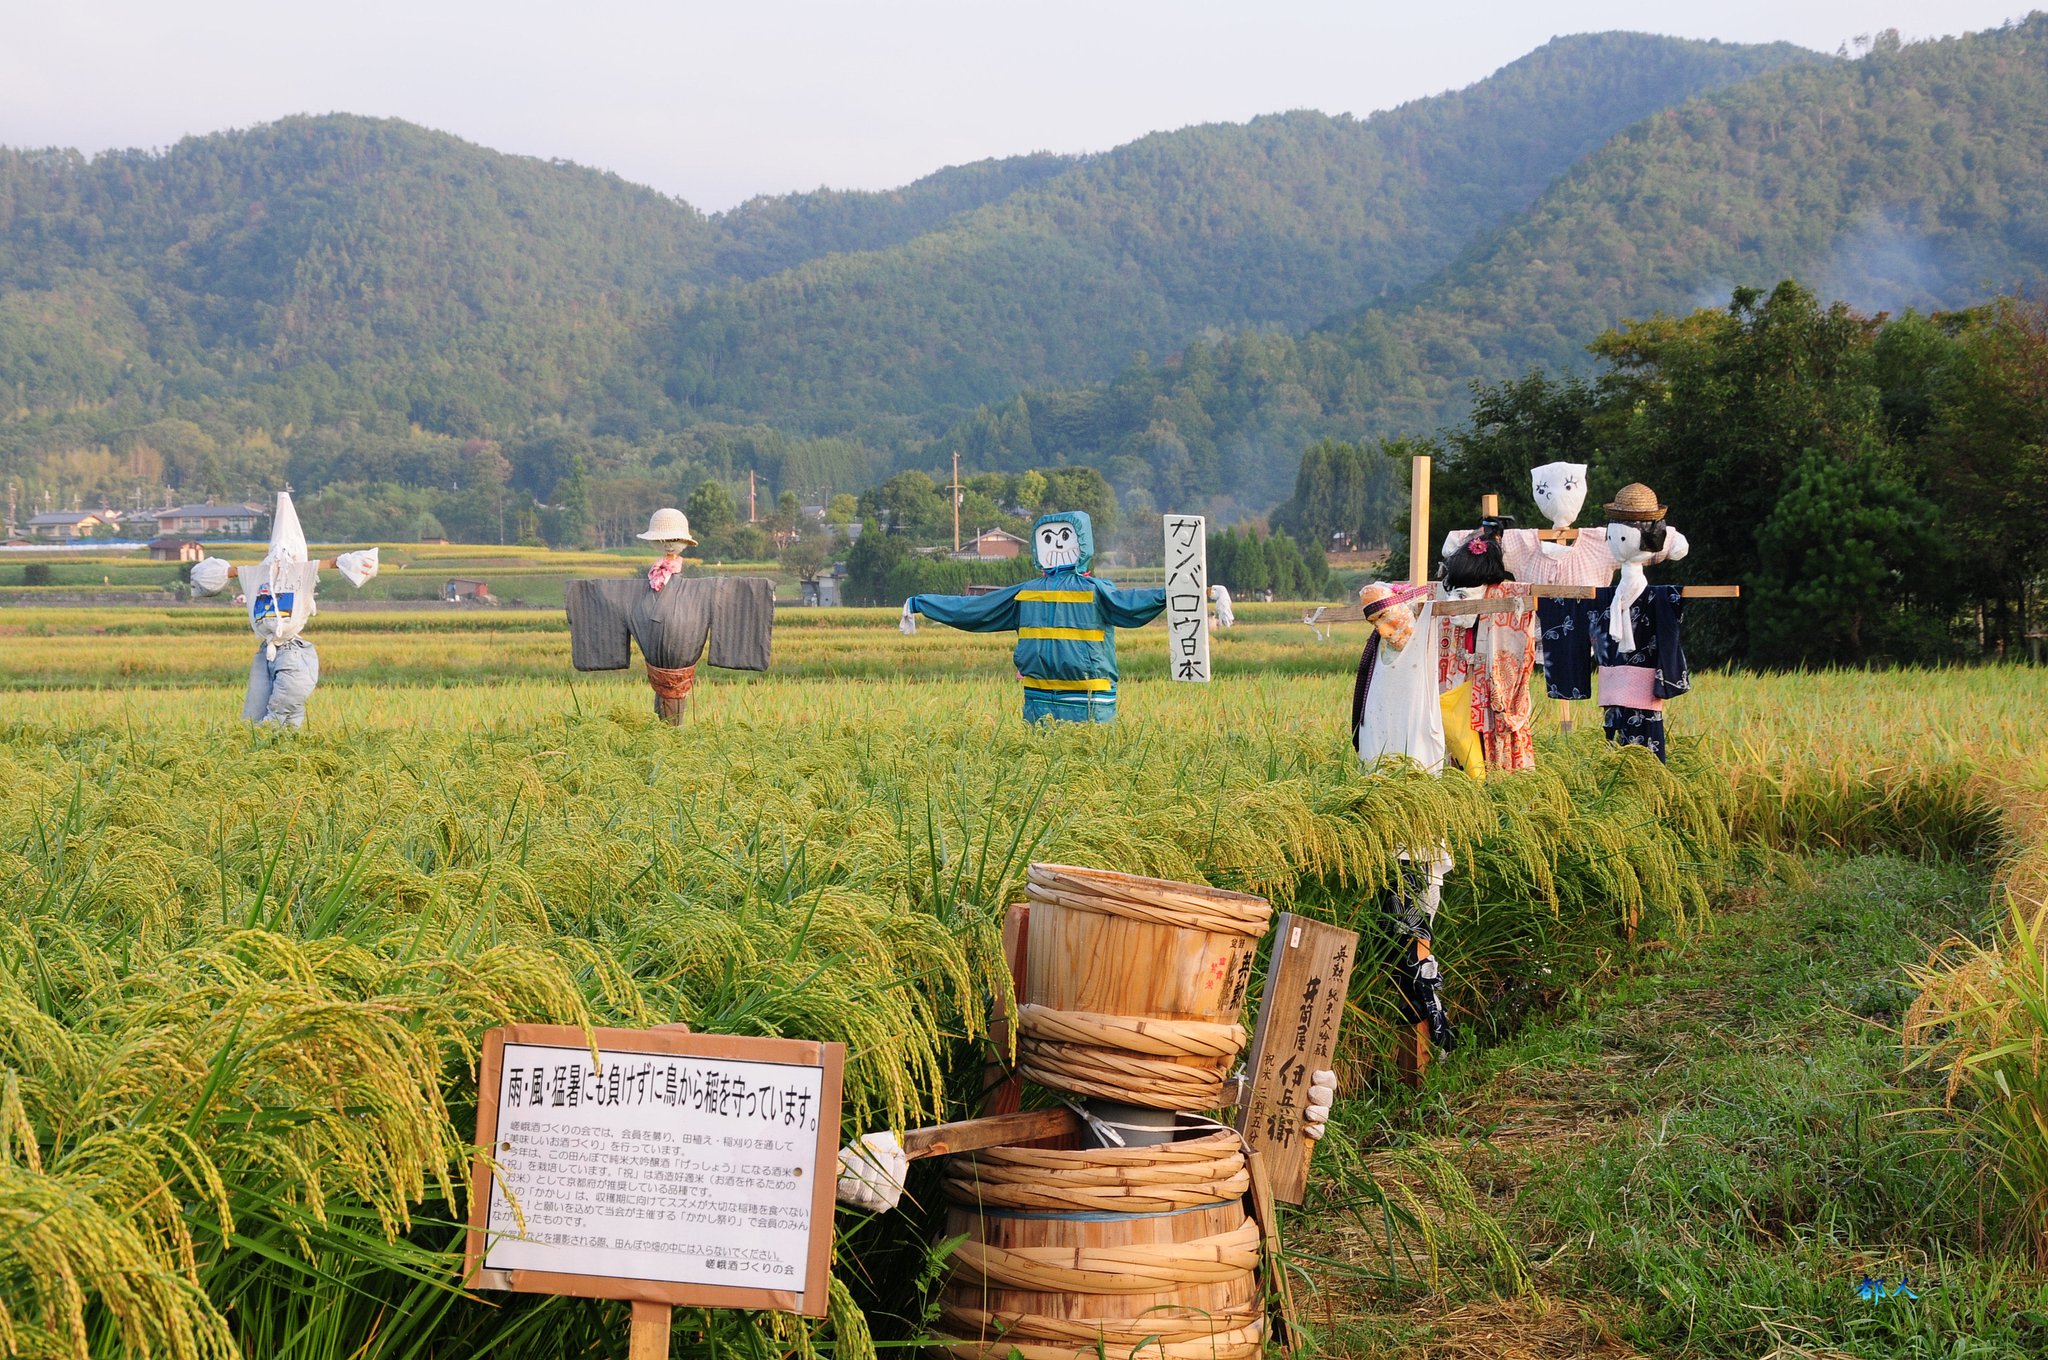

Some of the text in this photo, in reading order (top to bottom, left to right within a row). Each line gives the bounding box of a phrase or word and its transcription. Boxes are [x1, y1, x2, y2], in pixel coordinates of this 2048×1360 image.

[1168, 519, 1205, 680] ガンバロウ日本
[507, 1061, 817, 1132] 雨・風・猛暑にも負けずに鳥から稲を守っています。
[705, 1258, 795, 1276] 嵯峨酒づくりの会
